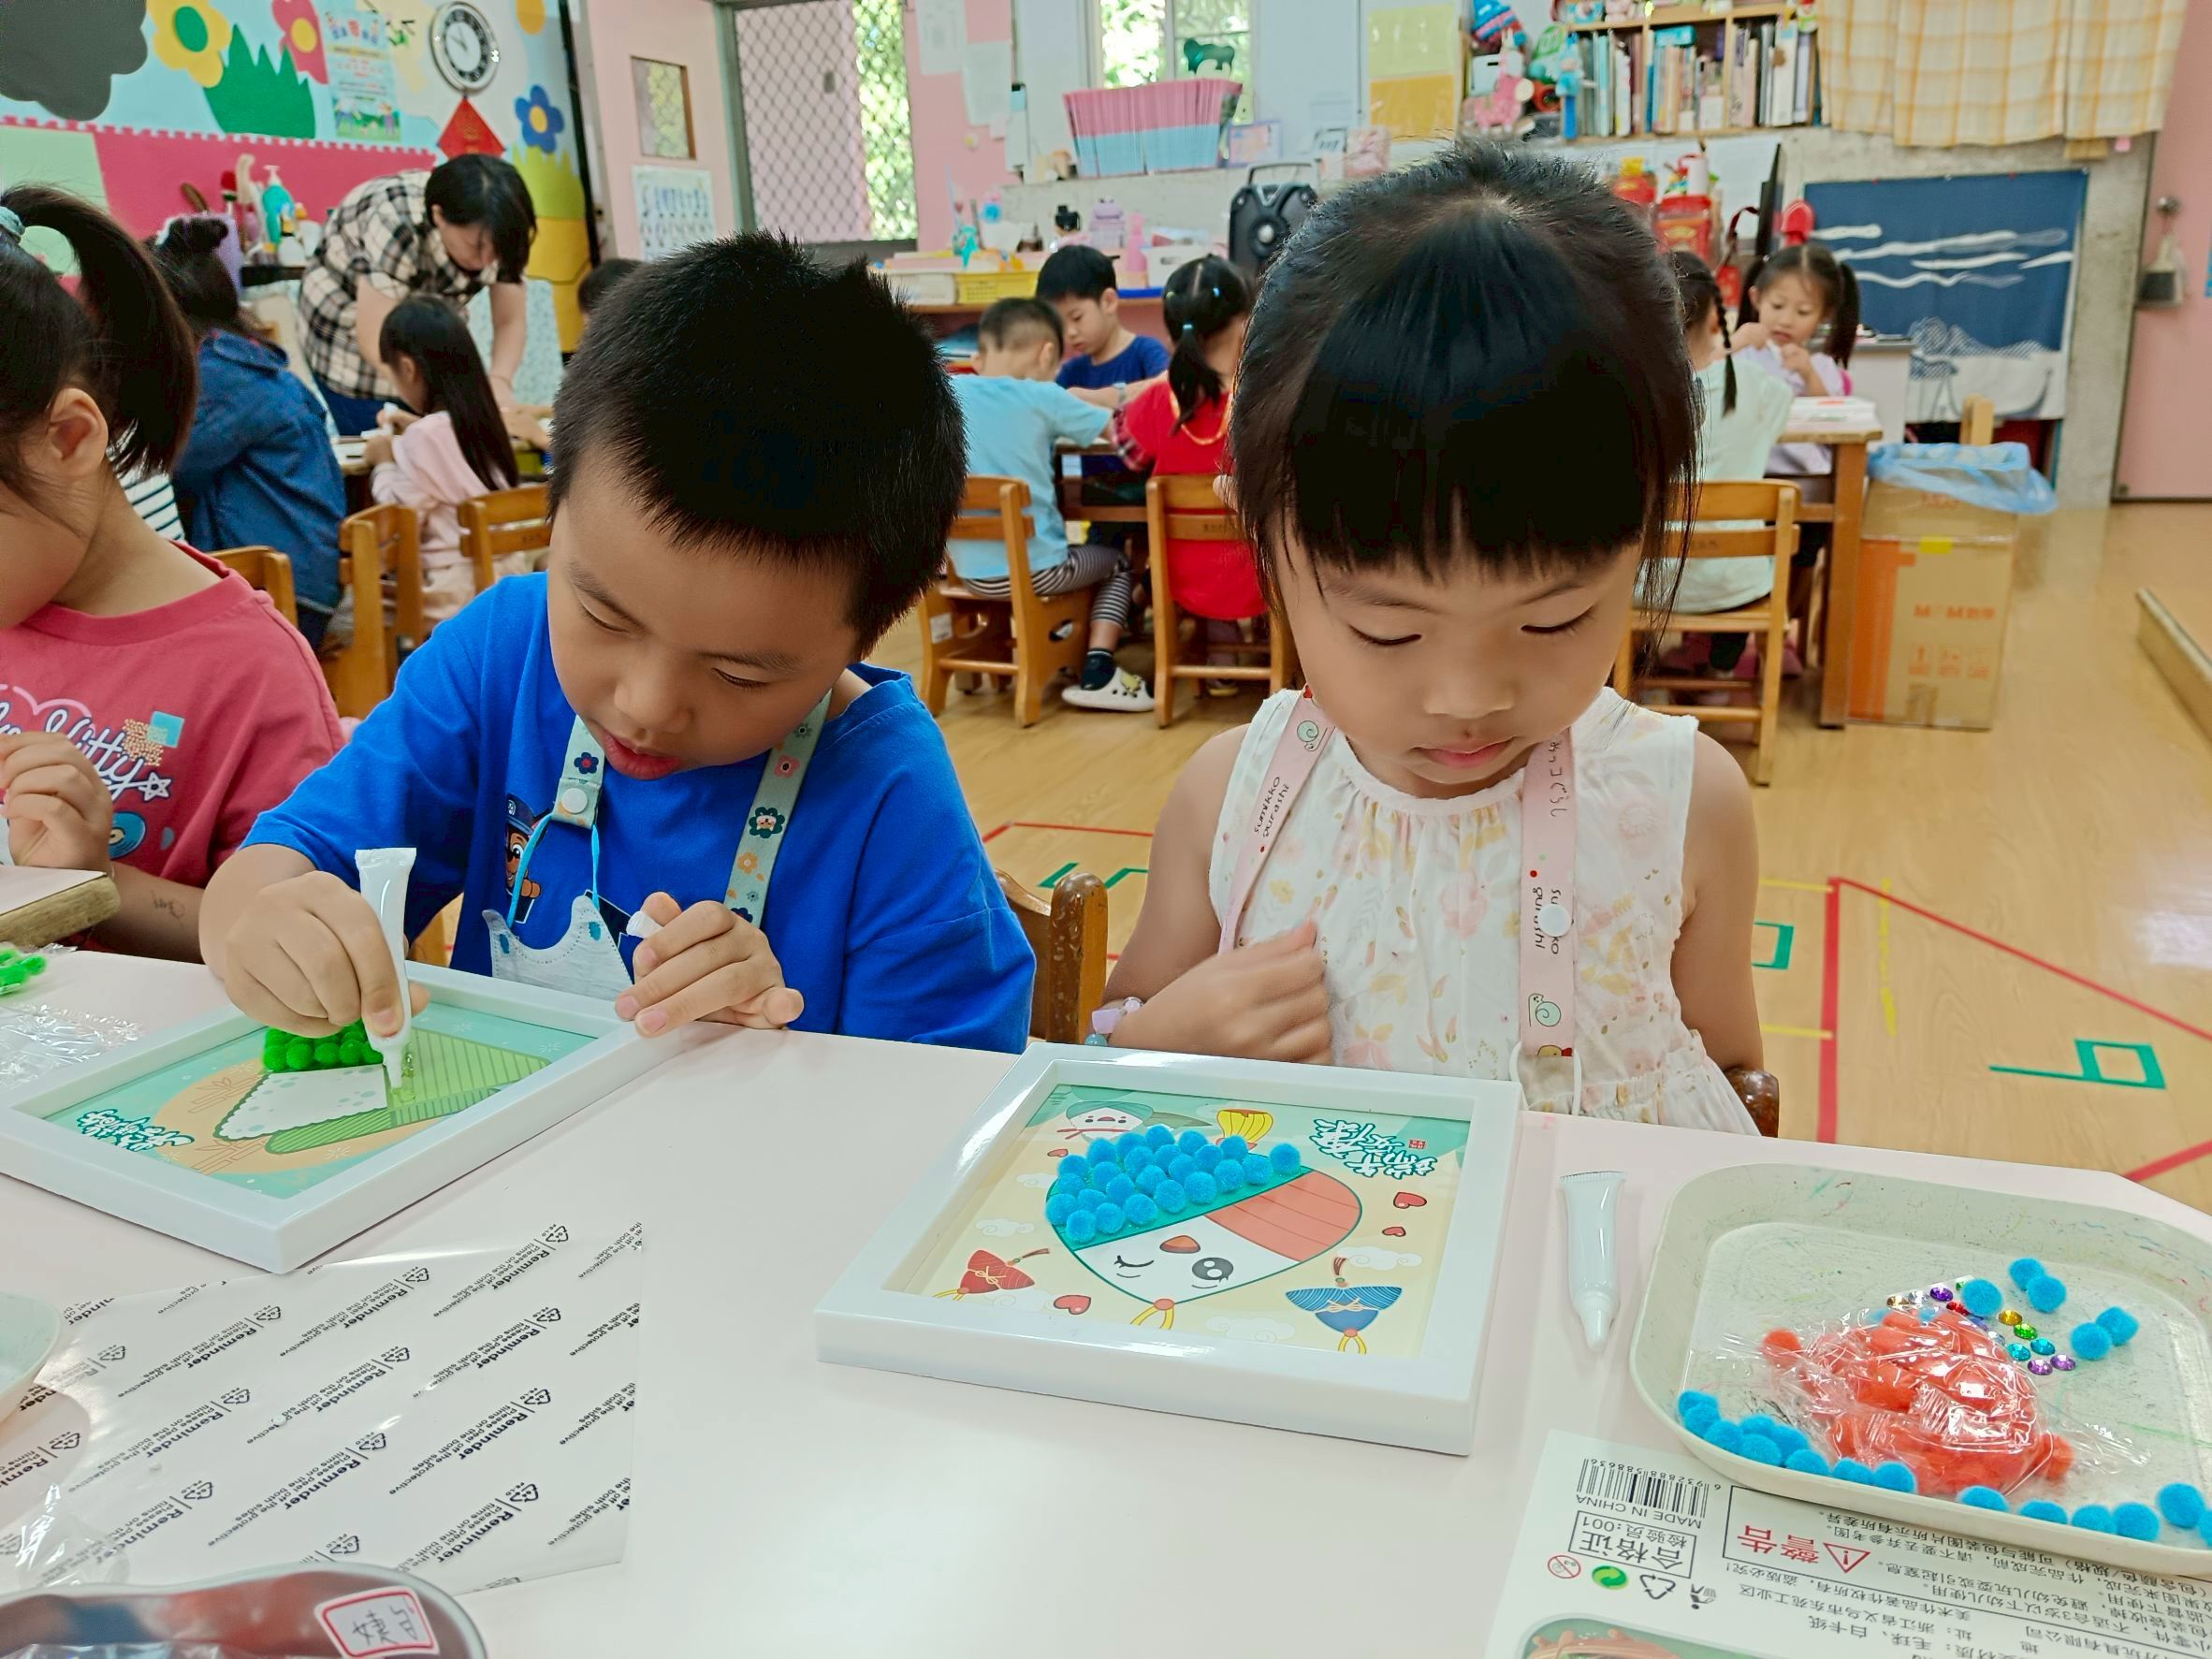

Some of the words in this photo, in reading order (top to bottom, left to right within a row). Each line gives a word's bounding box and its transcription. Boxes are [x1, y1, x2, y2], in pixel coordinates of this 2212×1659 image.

[514, 1244, 540, 1264] Please
[515, 1242, 534, 1256] films
[491, 1263, 505, 1273] the
[491, 1249, 549, 1289] Reminder
[494, 1260, 513, 1276] peel
[473, 1273, 492, 1285] both
[485, 1275, 496, 1285] off
[369, 1284, 399, 1302] Please
[371, 1281, 393, 1294] films
[471, 1282, 486, 1292] the
[361, 1294, 371, 1302] on
[432, 1290, 471, 1317] protective
[343, 1288, 407, 1328] Reminder
[345, 1302, 360, 1311] the
[349, 1301, 369, 1315] peel
[325, 1310, 345, 1323] both
[338, 1314, 349, 1323] off
[322, 1320, 337, 1331] the
[502, 1321, 524, 1334] films
[501, 1324, 531, 1342] Please
[187, 1327, 256, 1368] Reminder
[279, 1329, 321, 1356] protective
[476, 1342, 492, 1351] the
[476, 1328, 540, 1368] Reminder
[482, 1341, 501, 1355] peel
[457, 1350, 477, 1363] both
[470, 1353, 481, 1362] off
[348, 1361, 371, 1375] films
[454, 1361, 470, 1371] the
[335, 1375, 347, 1384] on
[344, 1364, 376, 1383] Please
[316, 1368, 386, 1412] Reminder
[318, 1383, 335, 1393] the
[323, 1382, 343, 1397] peel
[297, 1393, 319, 1406] both
[310, 1396, 323, 1406] off
[602, 1392, 621, 1406] both
[614, 1395, 626, 1405] off
[293, 1404, 310, 1415] the
[488, 1404, 511, 1419] films
[599, 1404, 615, 1415] the
[475, 1419, 488, 1428] on
[486, 1407, 517, 1428] Please
[458, 1412, 527, 1459] Reminder
[459, 1428, 475, 1439] the
[464, 1427, 485, 1443] peel
[559, 1414, 600, 1445] protective
[437, 1438, 459, 1453] both
[451, 1442, 464, 1453] off
[319, 1450, 344, 1466] films
[435, 1451, 452, 1463] the
[306, 1466, 319, 1476] on
[316, 1453, 351, 1477] Please
[1590, 1457, 1641, 1474] 588636
[284, 1459, 360, 1508] Reminder
[287, 1476, 305, 1487] the
[292, 1476, 314, 1492] peel
[388, 1461, 434, 1494] protective
[263, 1487, 287, 1503] both
[278, 1491, 291, 1502] off
[259, 1500, 277, 1512] the
[1575, 1493, 1626, 1512] CHINA
[467, 1506, 502, 1529] Please
[470, 1502, 495, 1519] films
[1631, 1506, 1647, 1517] IN
[457, 1519, 470, 1529] on
[1652, 1510, 1701, 1528] MADE
[208, 1510, 258, 1546] protective
[439, 1529, 457, 1541] the
[437, 1510, 513, 1562] Reminder
[443, 1526, 466, 1546] peel
[415, 1540, 439, 1557] both
[429, 1544, 444, 1556] off
[1735, 1523, 1822, 1564] 警告
[1579, 1530, 1684, 1572] 合格证
[411, 1552, 429, 1566] the
